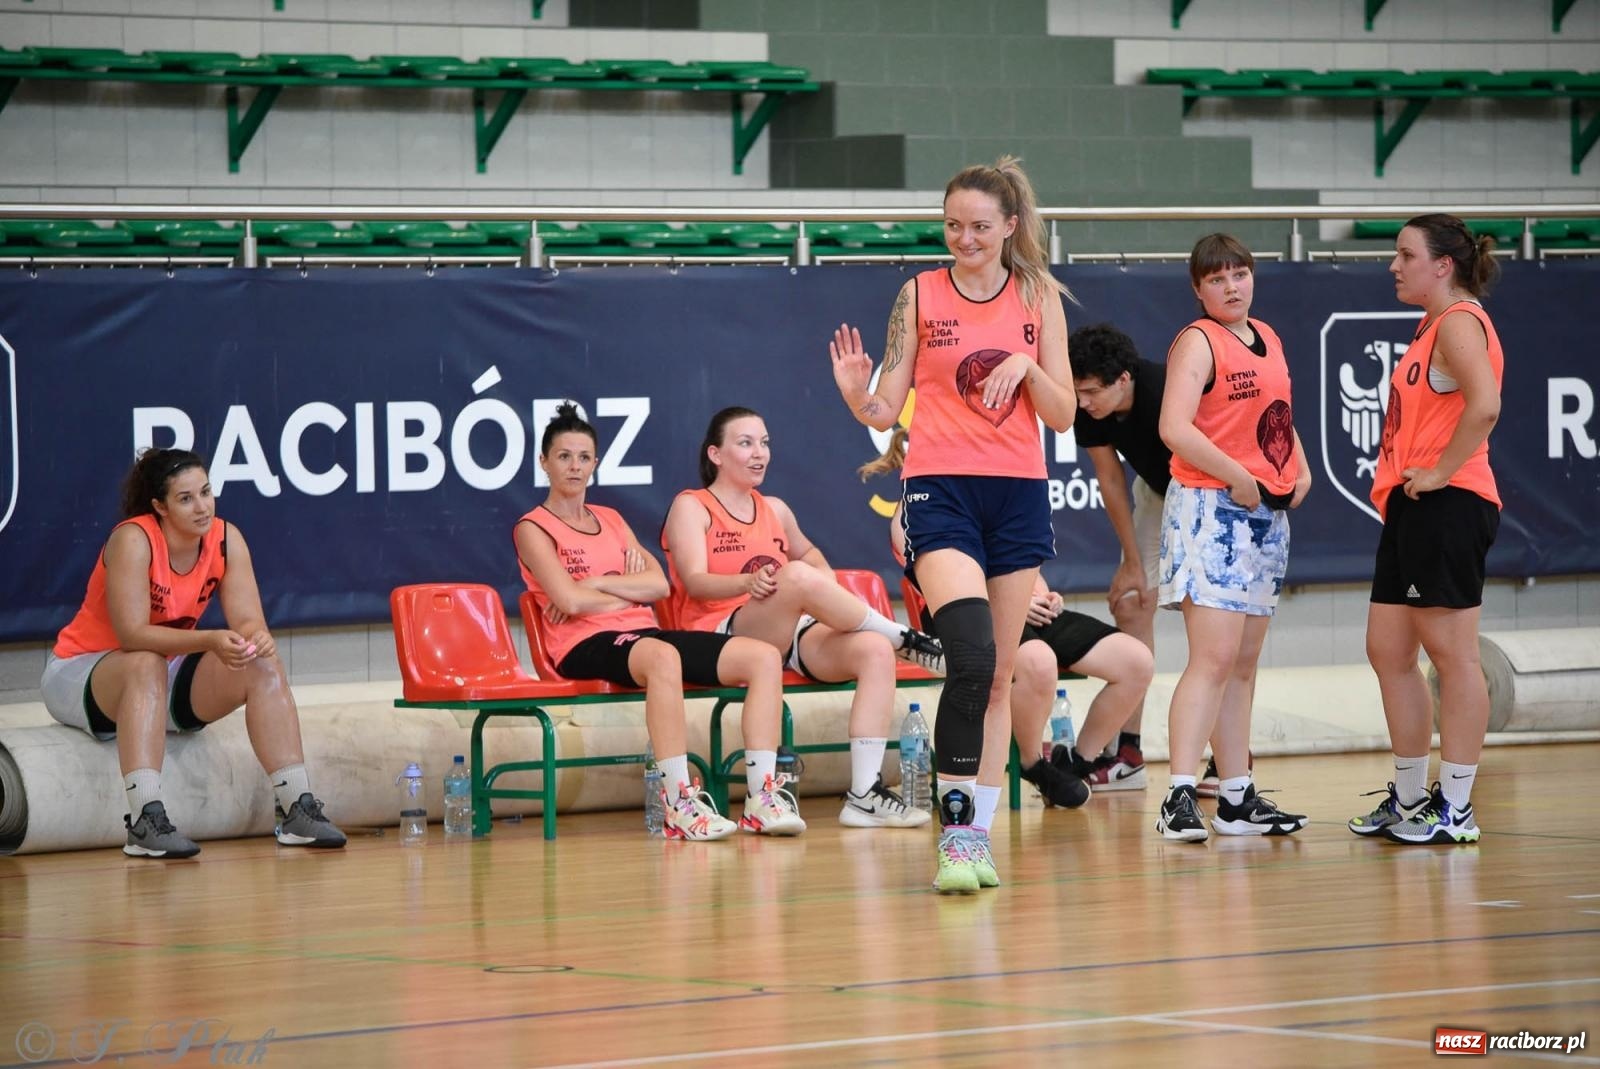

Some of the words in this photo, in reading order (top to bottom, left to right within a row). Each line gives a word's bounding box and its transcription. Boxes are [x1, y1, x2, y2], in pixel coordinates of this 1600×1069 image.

[924, 319, 959, 329] LETNIA
[931, 328, 953, 338] LIGA
[1023, 323, 1035, 345] 8
[927, 337, 960, 348] KOBIET
[1225, 370, 1258, 382] LETNIA
[1406, 361, 1421, 386] 0
[1233, 380, 1256, 391] LIGA
[1228, 388, 1261, 401] KOBIET
[1547, 376, 1600, 459] R
[713, 545, 746, 554] KOBIET
